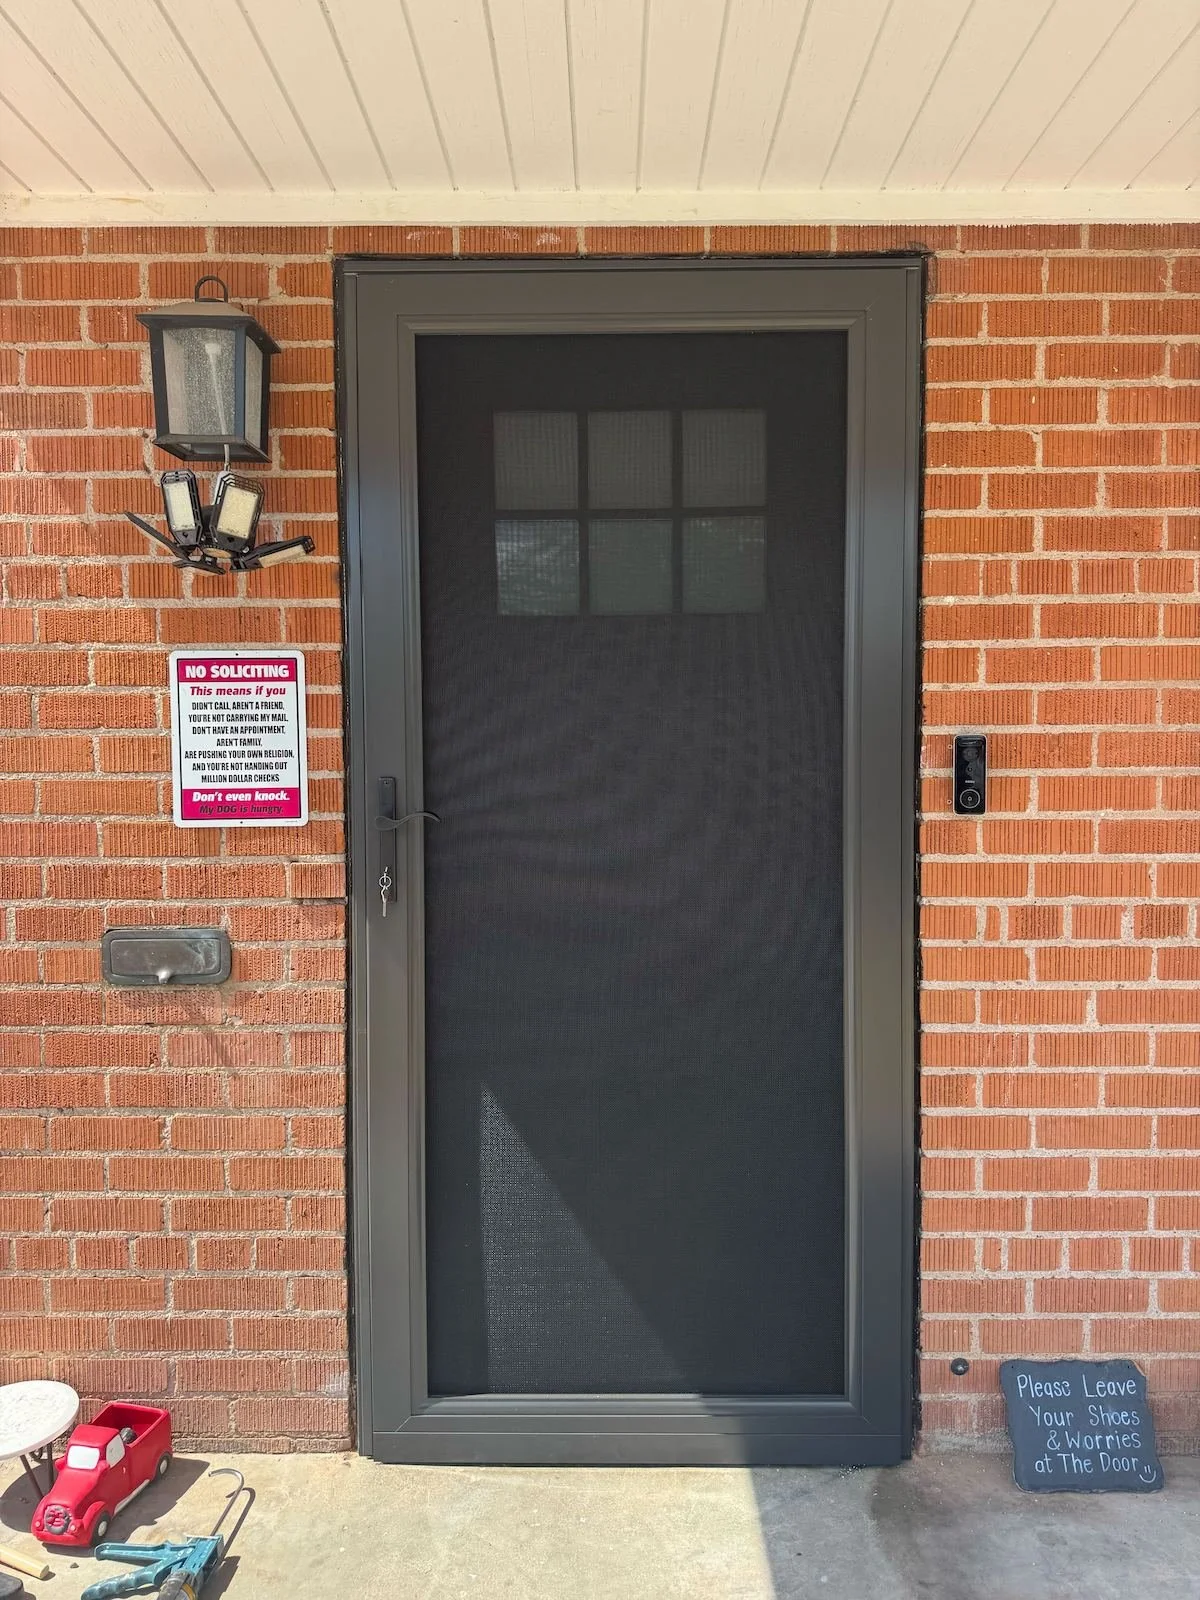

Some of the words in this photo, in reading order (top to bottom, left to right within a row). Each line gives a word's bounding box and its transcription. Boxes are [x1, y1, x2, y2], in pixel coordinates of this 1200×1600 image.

[185, 665, 206, 678] NO
[210, 665, 289, 678] SOLICITING
[190, 686, 212, 696] This
[216, 687, 252, 696] means
[255, 686, 263, 695] if
[266, 687, 286, 697] you
[192, 702, 213, 710] DIDN'T
[232, 702, 255, 710] AREN'T
[261, 702, 285, 710] FRIEND,
[189, 714, 211, 723] YOU'RE
[212, 714, 225, 722] NOT
[226, 714, 259, 722] CARRYING
[260, 714, 271, 722] MY
[192, 726, 211, 734] DON'T
[212, 726, 229, 734] HAVE
[230, 726, 239, 734] AN
[240, 726, 286, 734] APPOINTMENT,
[217, 739, 239, 747] AREN'T
[240, 738, 263, 746] FAMILY,
[198, 750, 227, 758] PUSHING
[228, 750, 246, 758] YOUR
[247, 750, 263, 758] OWN
[264, 750, 294, 758] RELIGION,
[192, 763, 206, 771] AND
[207, 763, 229, 771] YOU'RE
[244, 762, 273, 770] HANDING
[201, 775, 227, 783] MILLION
[229, 774, 252, 783] DOLLAR
[254, 774, 280, 782] CHECKS
[192, 792, 222, 802] Don't
[225, 793, 251, 801] even
[254, 791, 290, 800] knock.
[200, 806, 214, 815] My
[251, 805, 283, 814] hungry.
[1016, 1374, 1071, 1398] Please
[1082, 1374, 1137, 1397] Leave
[1029, 1405, 1074, 1426] Your
[1088, 1405, 1140, 1426] Shoes
[1046, 1430, 1060, 1450] &
[1065, 1430, 1141, 1450] Worries
[1035, 1453, 1053, 1473] at
[1057, 1453, 1093, 1474] The
[1100, 1452, 1139, 1472] Door
